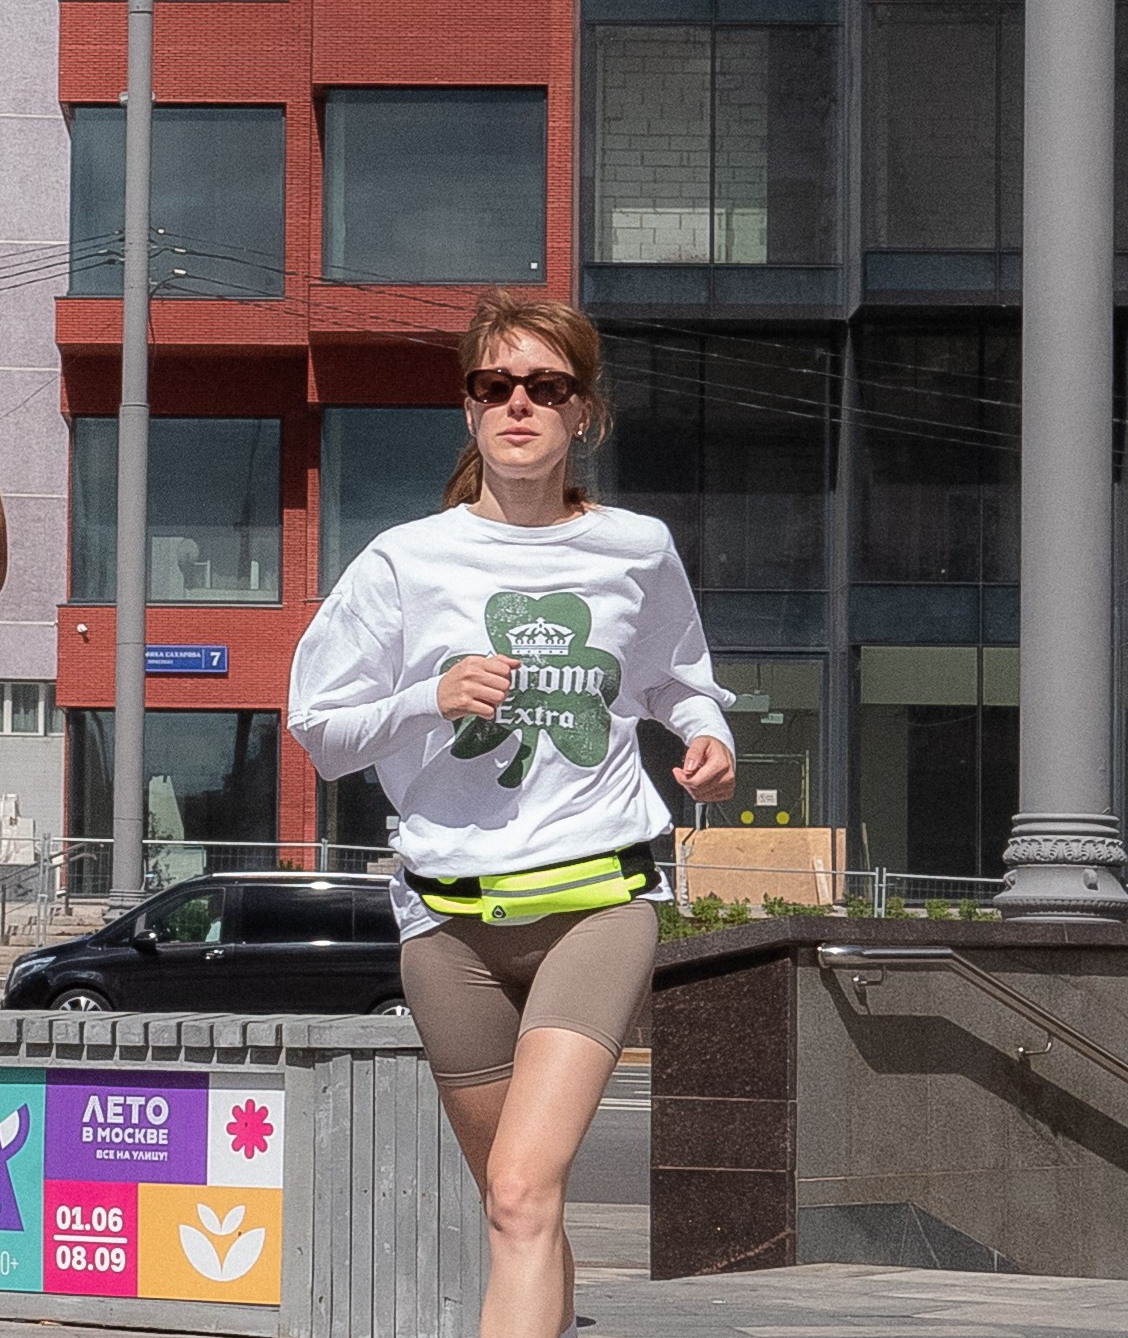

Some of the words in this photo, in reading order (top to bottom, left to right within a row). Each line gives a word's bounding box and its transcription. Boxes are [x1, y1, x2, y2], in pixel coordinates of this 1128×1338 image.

[210, 651, 221, 666] 7
[509, 664, 605, 697] rona
[495, 704, 575, 729] Extra
[82, 1095, 169, 1125] ЛЕТО
[82, 1126, 93, 1142] В
[97, 1127, 169, 1145] МОСКВЕ
[96, 1149, 115, 1159] ВСЕ
[116, 1150, 131, 1160] НА
[132, 1151, 168, 1161] УЛИЦУ!
[56, 1205, 123, 1232] 01.06
[56, 1245, 126, 1272] 08.09
